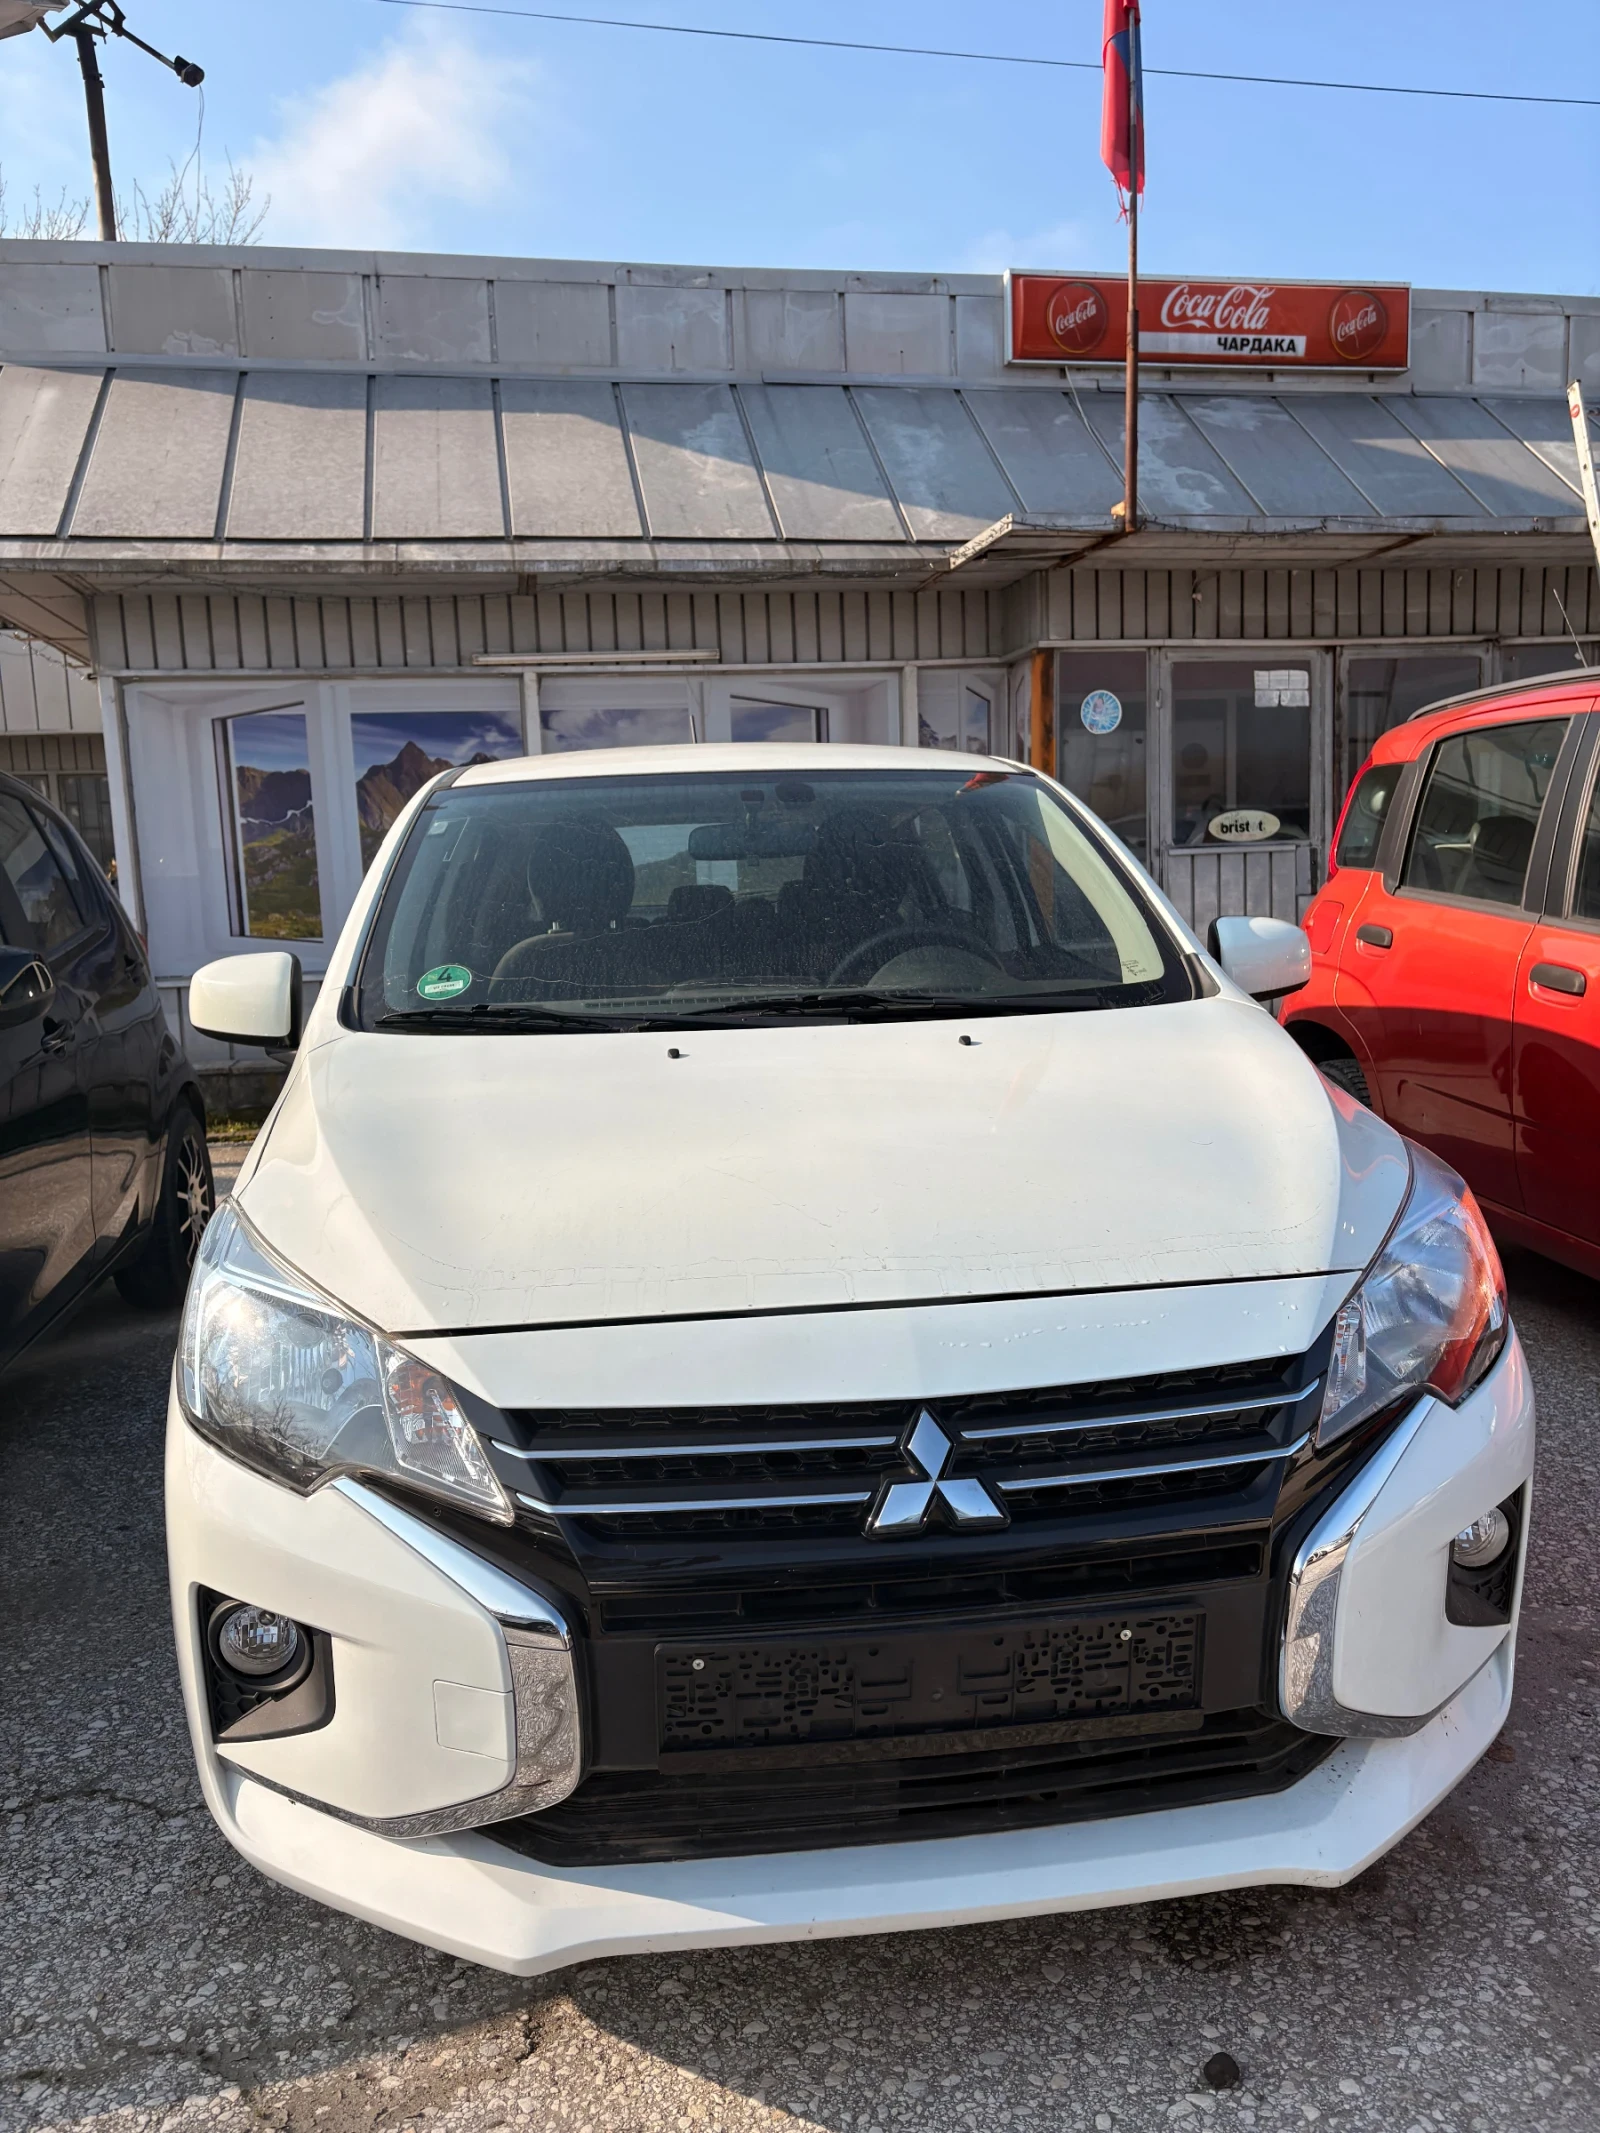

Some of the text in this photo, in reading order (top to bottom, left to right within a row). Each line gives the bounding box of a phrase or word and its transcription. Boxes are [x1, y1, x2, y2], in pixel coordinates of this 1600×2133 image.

[1161, 284, 1275, 330] Coca-Cola
[1217, 336, 1296, 355] ЧАРДАКА
[437, 967, 453, 982] 4
